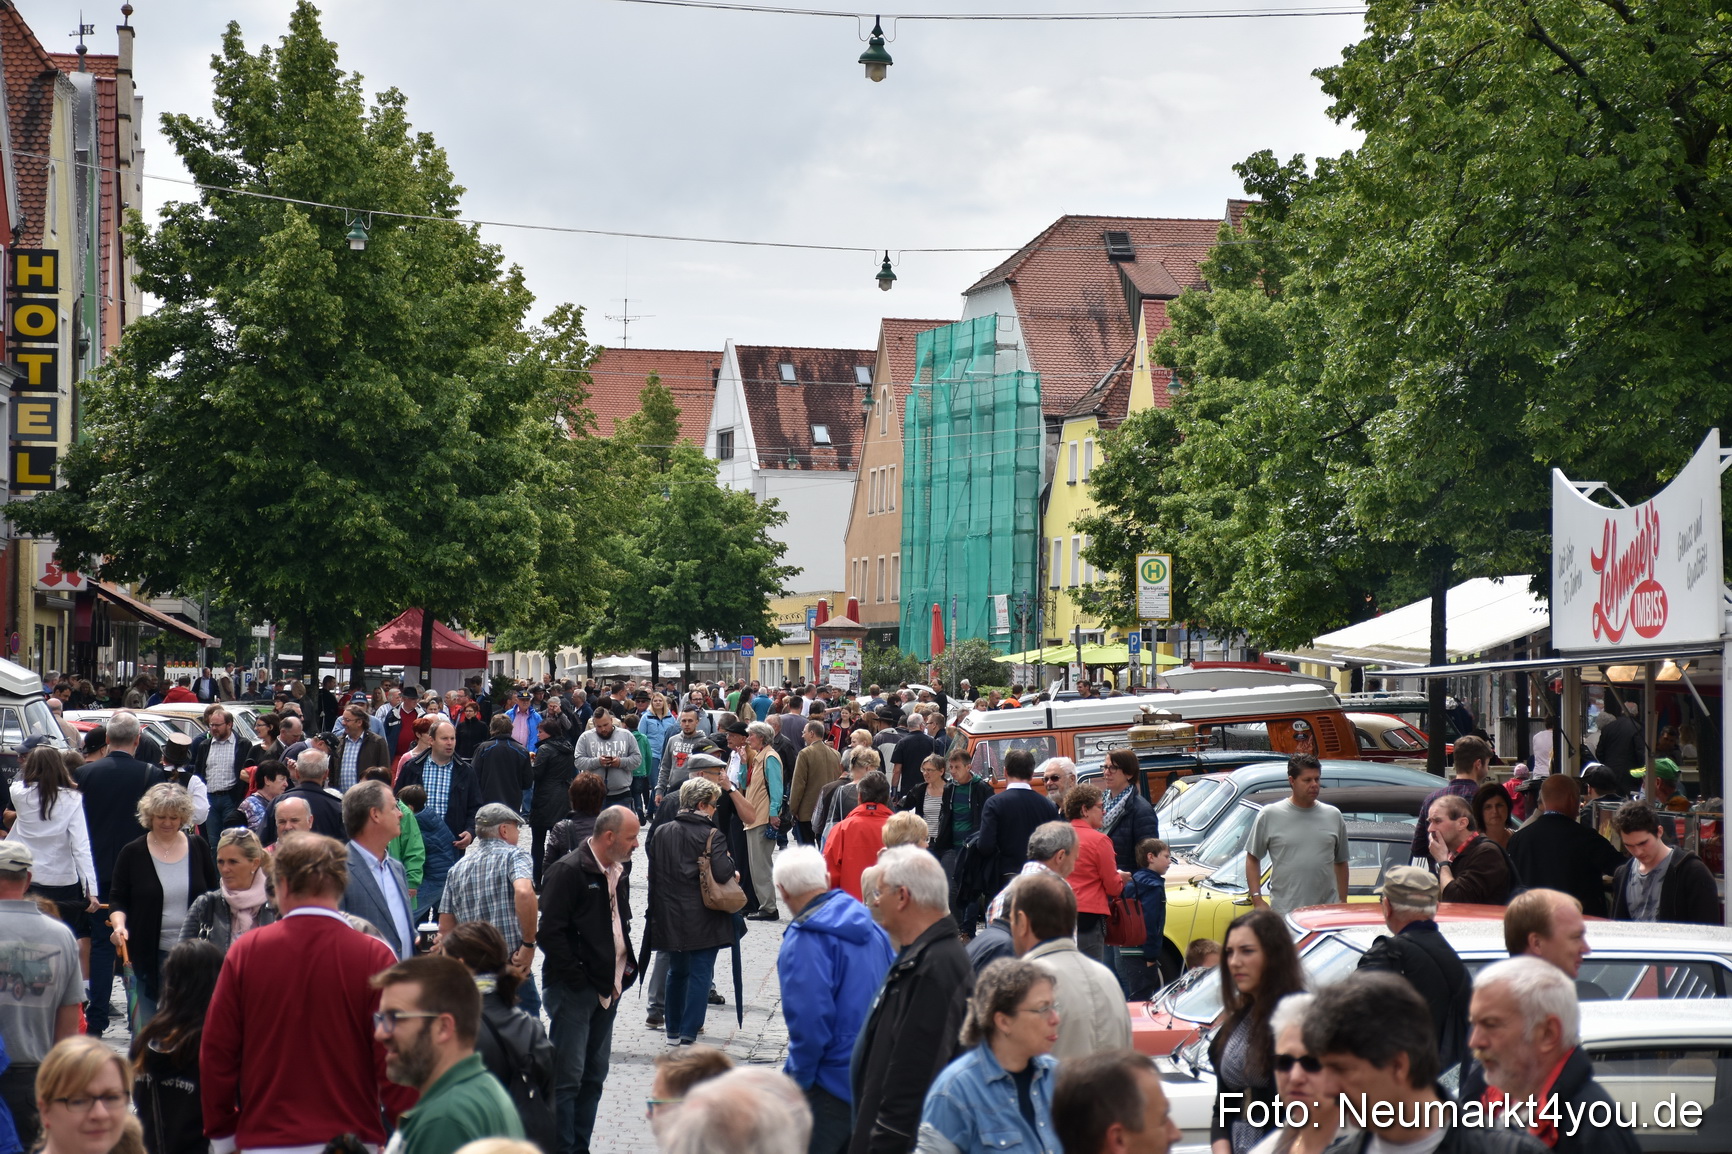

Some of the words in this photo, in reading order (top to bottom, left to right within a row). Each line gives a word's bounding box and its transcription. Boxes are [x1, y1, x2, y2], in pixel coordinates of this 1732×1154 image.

[14, 254, 57, 485] HOTEL
[1590, 498, 1661, 643] Lehmeier's
[1634, 590, 1664, 628] IMBISS
[1131, 635, 1138, 652] P
[674, 741, 695, 749] CHICAG
